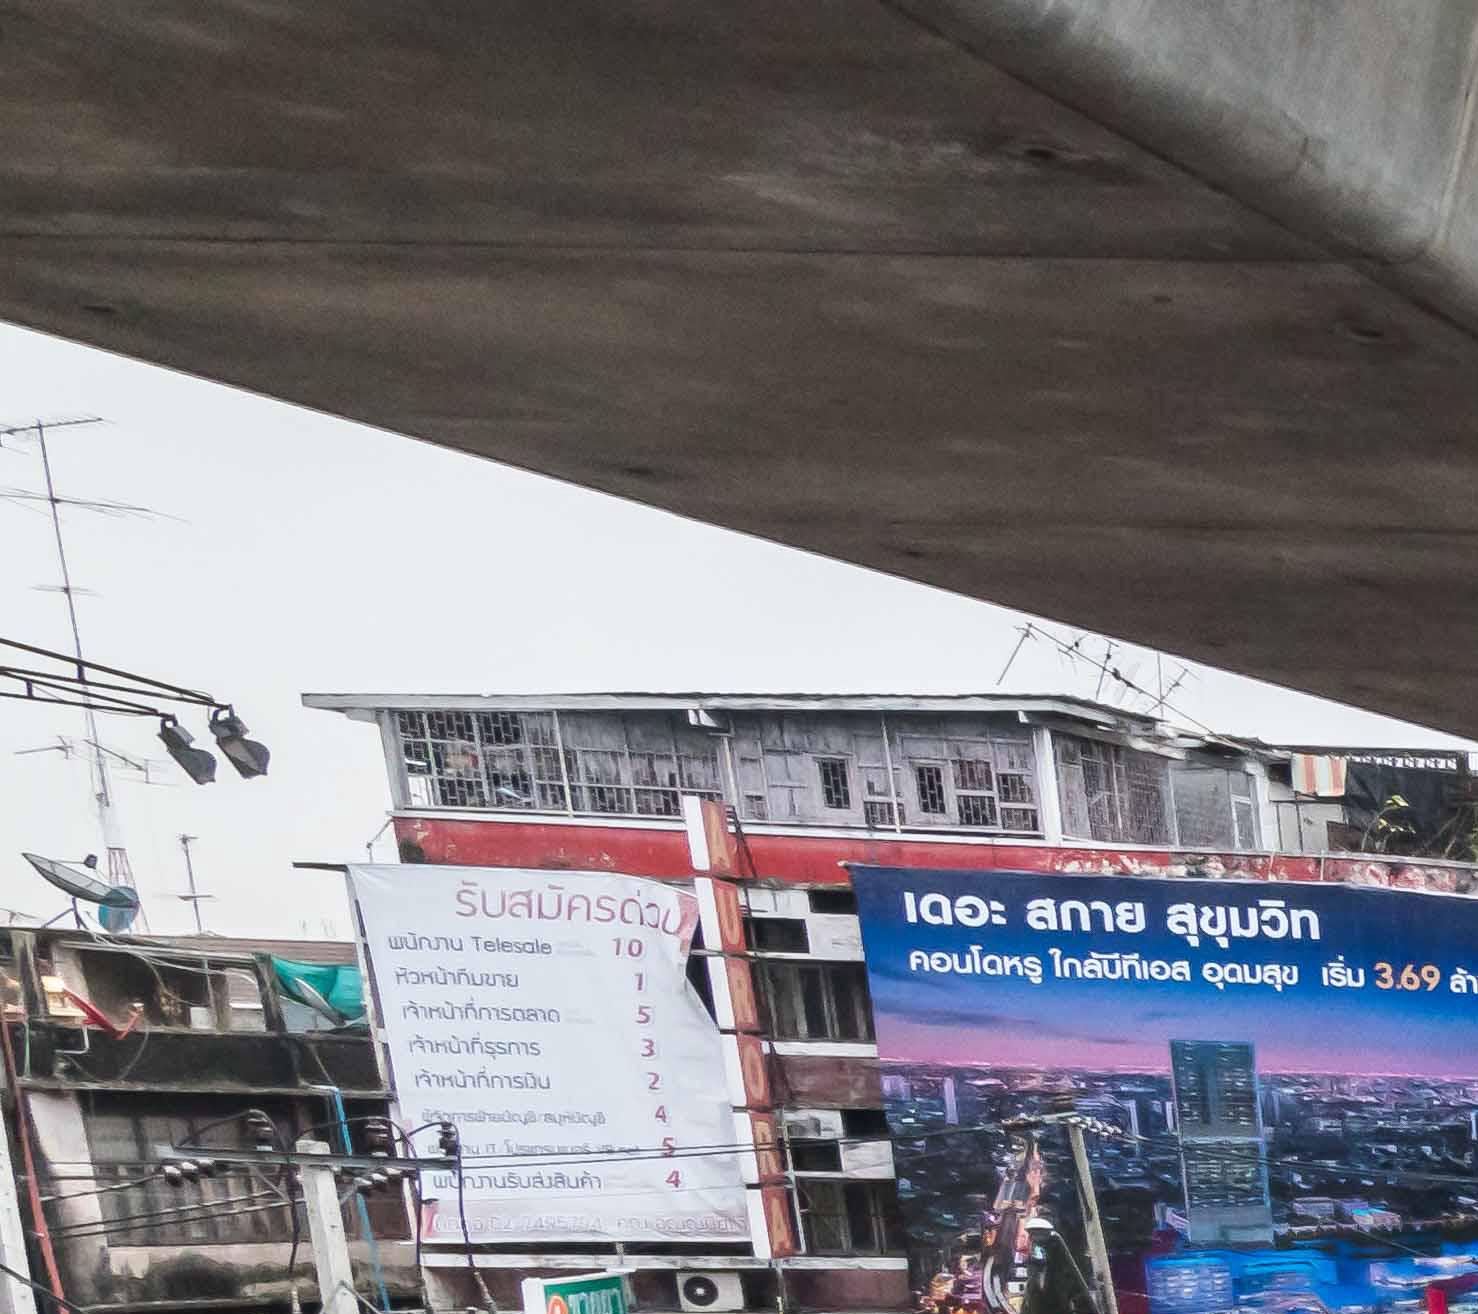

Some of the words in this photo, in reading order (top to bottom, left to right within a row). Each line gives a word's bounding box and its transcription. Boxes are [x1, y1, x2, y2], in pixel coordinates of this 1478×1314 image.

[903, 892, 1007, 928] เดอะ
[1026, 897, 1146, 932] สกาย
[1167, 899, 1321, 947] สุขุมวิท
[388, 934, 463, 953] พนักงาน
[471, 936, 552, 955] Telesale
[612, 938, 644, 957] 10
[909, 945, 1042, 984] คอนโดหรู
[1049, 948, 1191, 981] ใกล้บีทีเอส
[1202, 961, 1298, 991] อุดมสุข
[1321, 954, 1364, 988] เริ่ม
[1374, 962, 1441, 991] 3.69
[396, 967, 519, 988] หัวหน้าทีมขาย
[634, 973, 645, 991] 1
[402, 998, 560, 1024] เจ้าหน้าที่การตลาด
[636, 1006, 651, 1024] 5
[641, 1039, 656, 1057] 3
[648, 1072, 662, 1090] 2
[654, 1106, 668, 1124] 4
[662, 1137, 676, 1157] 5
[665, 1170, 680, 1188] 4
